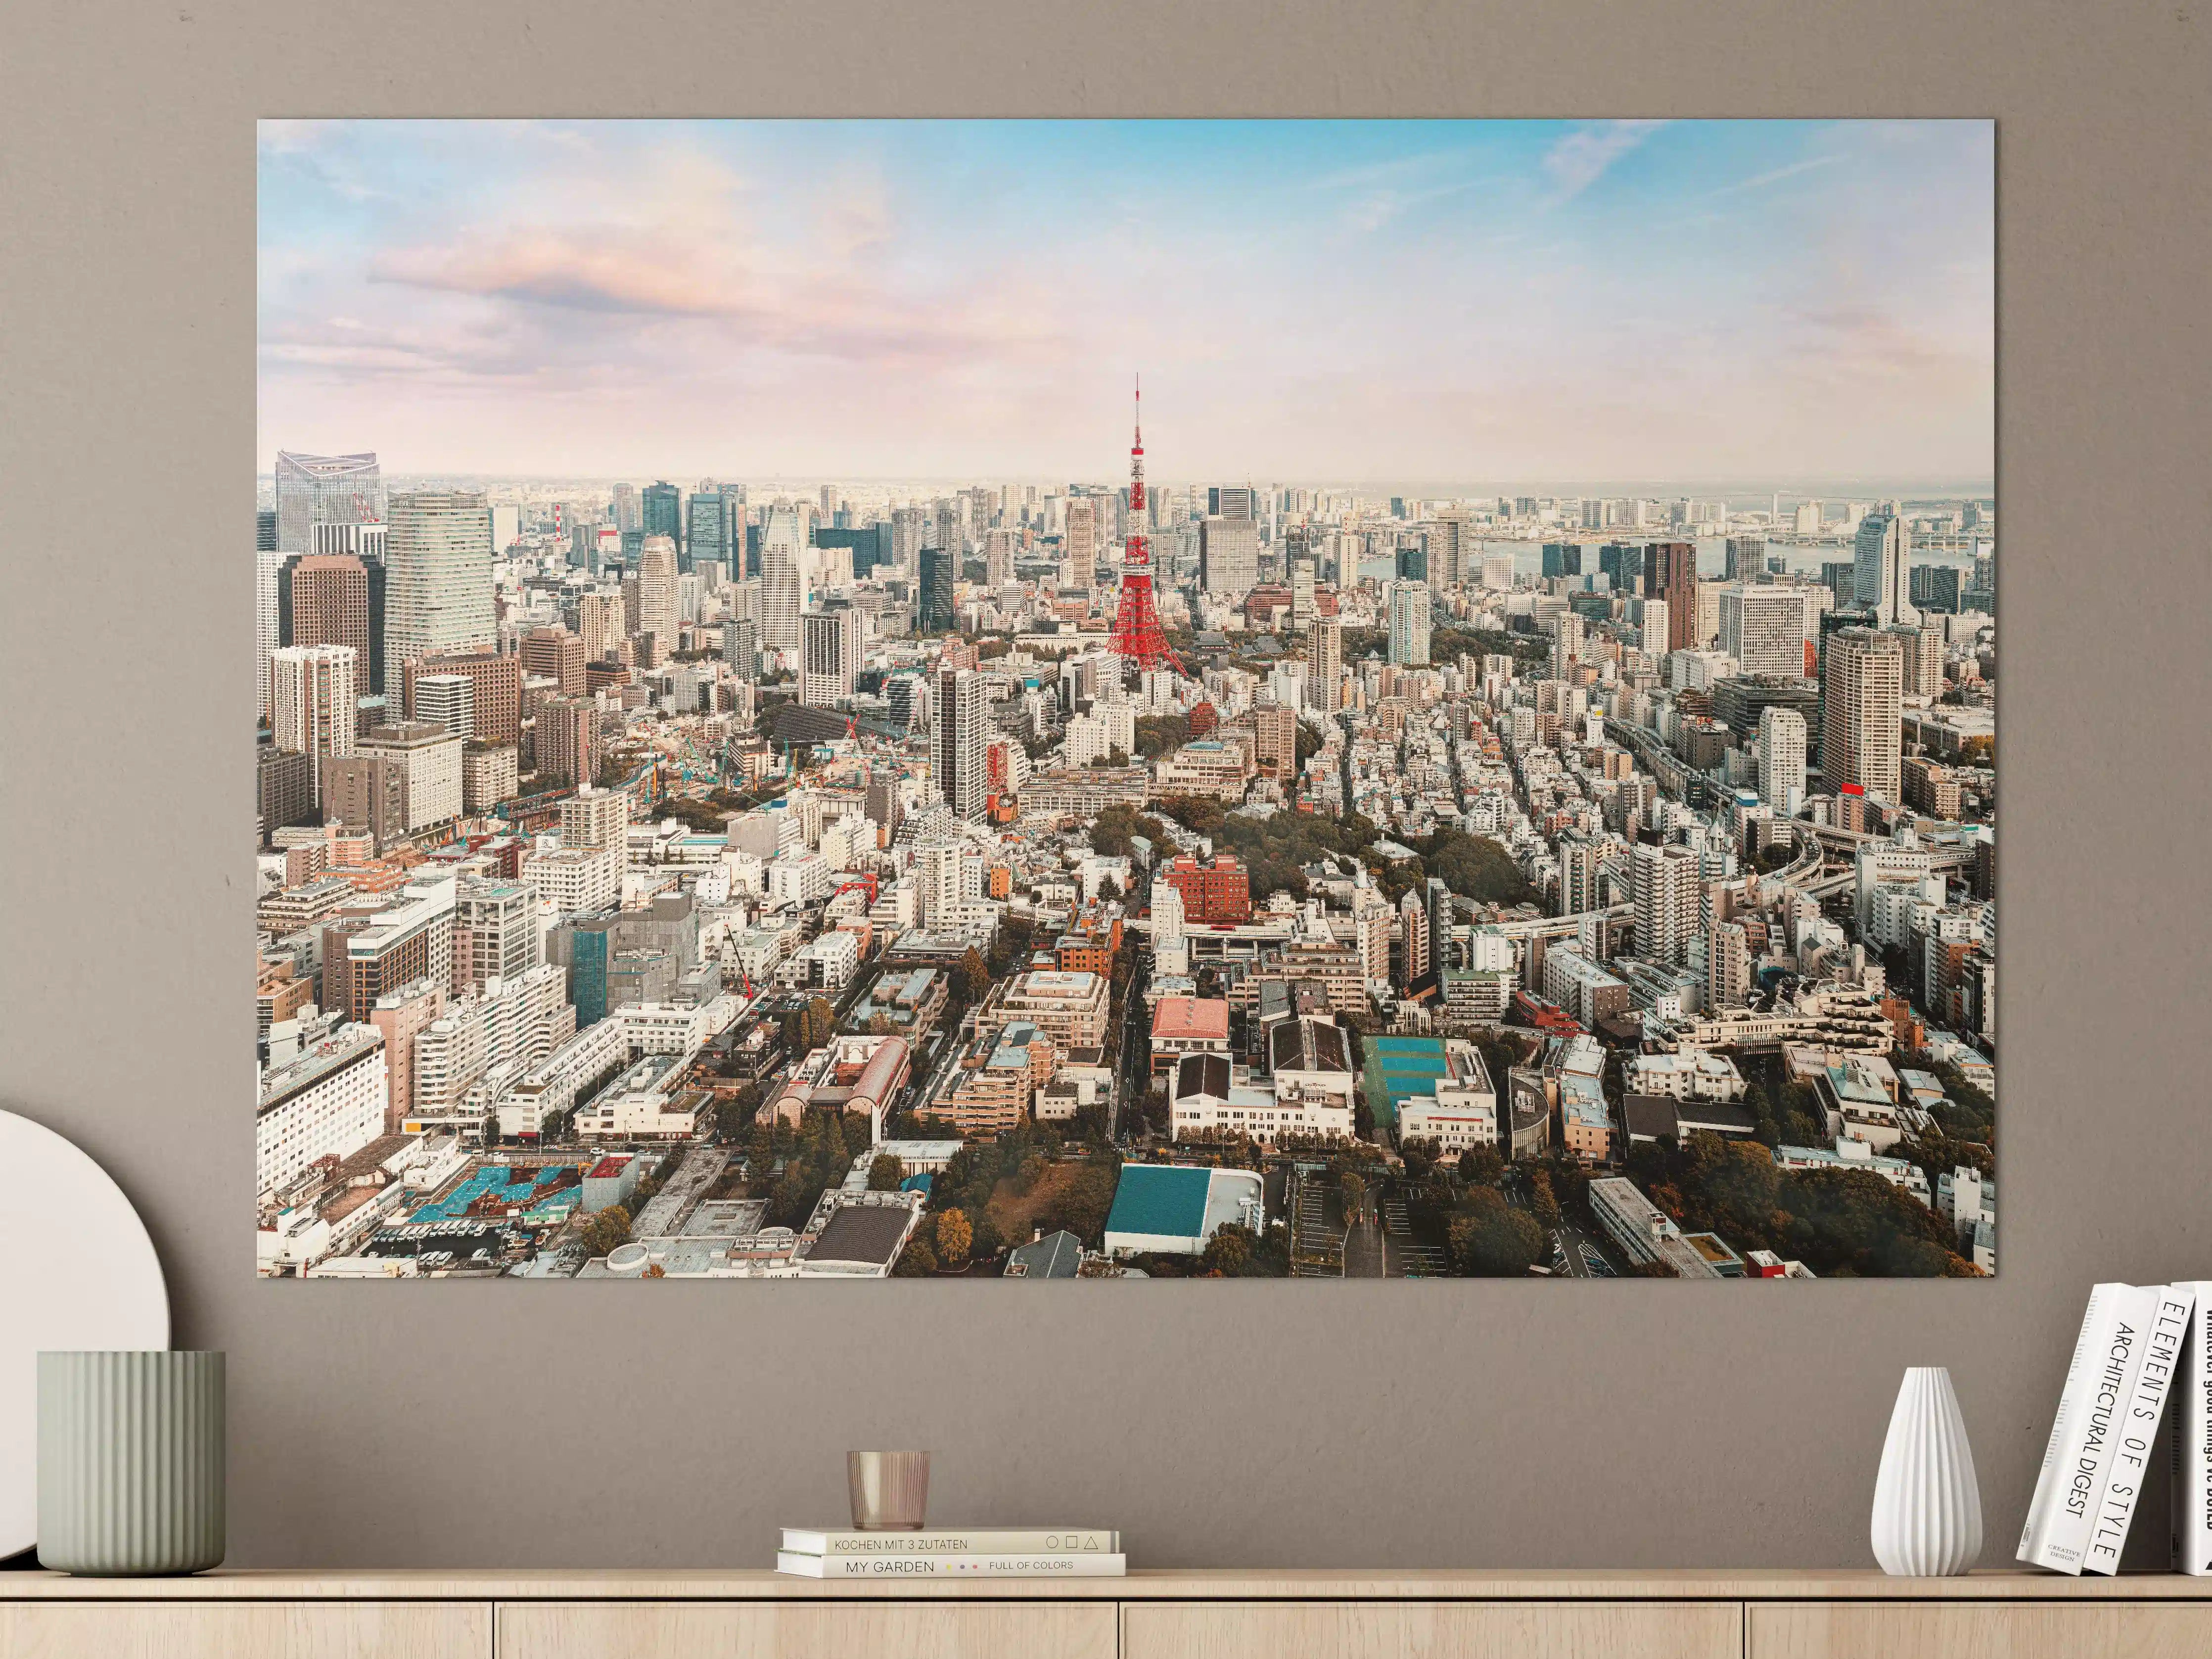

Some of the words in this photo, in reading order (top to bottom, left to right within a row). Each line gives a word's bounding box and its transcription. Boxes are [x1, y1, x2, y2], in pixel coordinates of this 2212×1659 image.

[2134, 1302, 2185, 1420] ELEMENTS
[2083, 1322, 2135, 1452] ARCHITECTURAL
[2121, 1438, 2146, 1468] OF
[2066, 1458, 2097, 1519] DIGEST
[2094, 1484, 2133, 1558] STYLE
[835, 1540, 881, 1550] KOCHEN
[885, 1540, 905, 1550] MIT
[909, 1540, 915, 1550] 3
[919, 1539, 968, 1549] ZUTATEN
[2048, 1544, 2081, 1557] CREATIVE
[2050, 1551, 2075, 1562] DESIGN
[846, 1562, 868, 1572] MY
[874, 1562, 934, 1572] GARDEN
